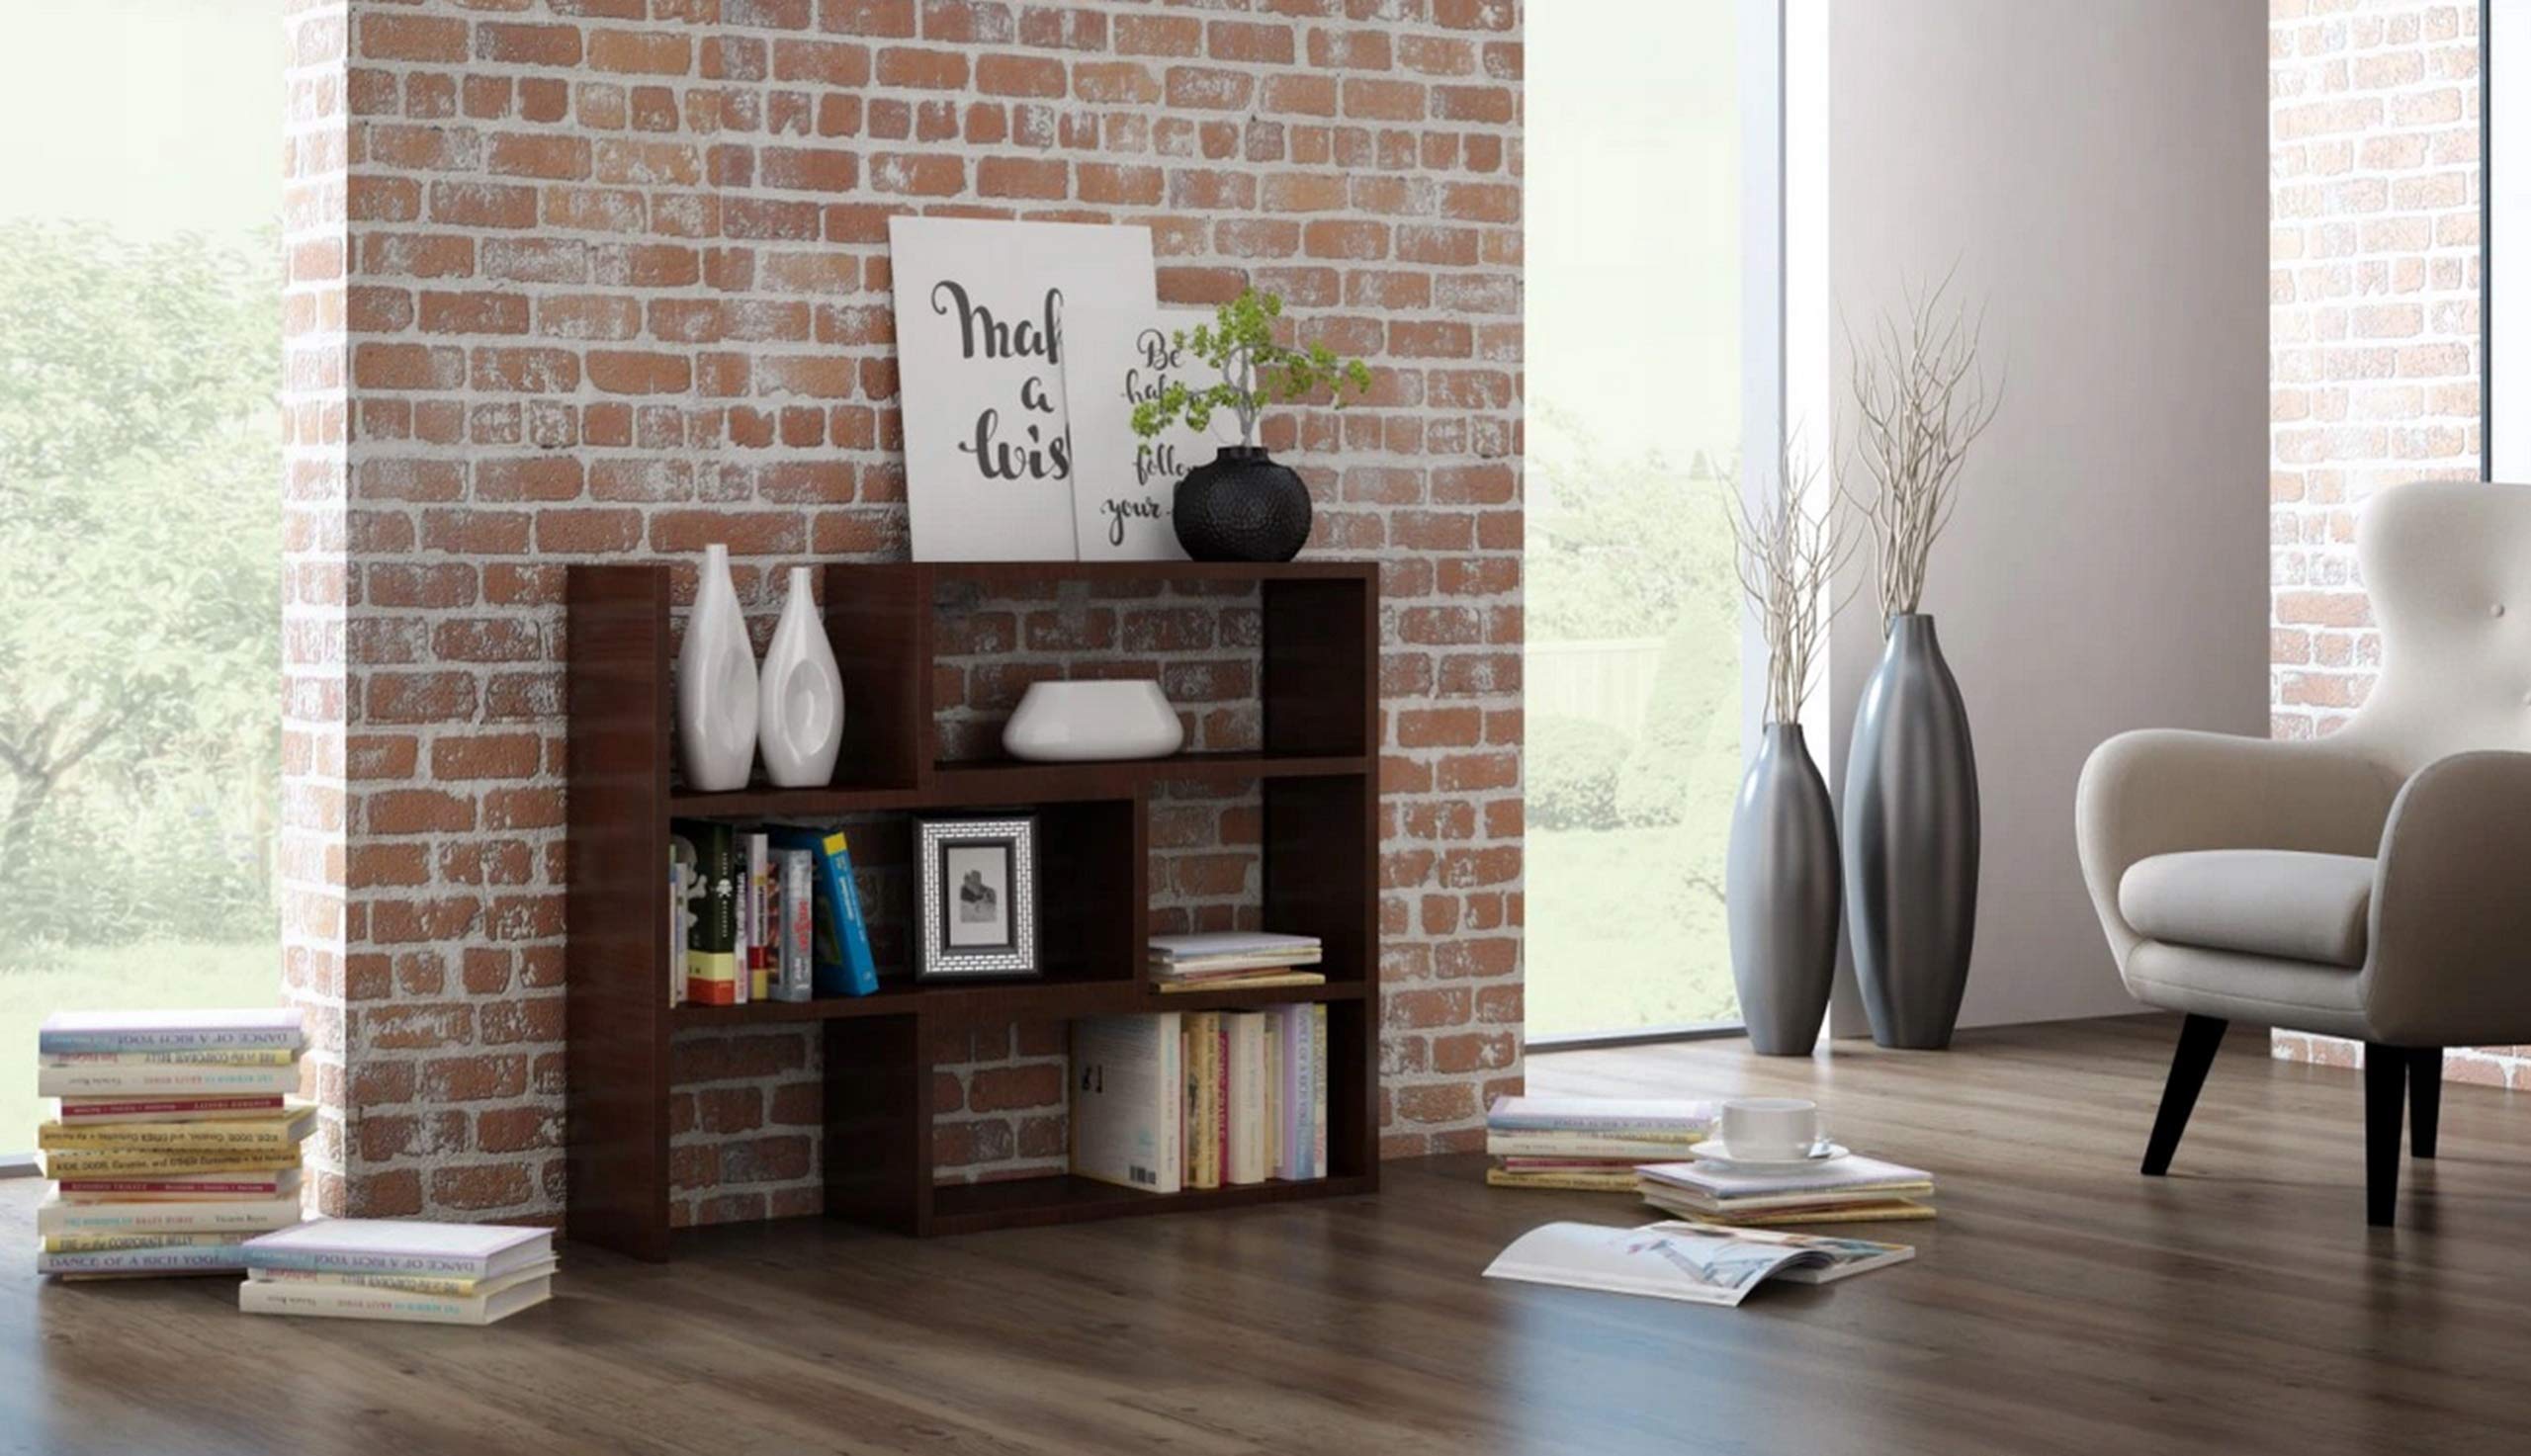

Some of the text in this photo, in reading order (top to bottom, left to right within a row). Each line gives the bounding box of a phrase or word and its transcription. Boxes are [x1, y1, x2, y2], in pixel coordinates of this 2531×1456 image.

[931, 281, 1063, 365] Mak
[1137, 329, 1185, 371] Be
[1020, 376, 1054, 413] a
[958, 408, 1072, 479] Wis
[1132, 443, 1193, 485] follo
[1098, 496, 1162, 546] your
[160, 1034, 195, 1045] RICH
[216, 1034, 234, 1044] OF
[240, 1033, 287, 1044] DANCE
[48, 1257, 96, 1266] DANCE
[104, 1256, 123, 1266] OF
[143, 1255, 178, 1265] RICH
[350, 1256, 386, 1267] RICH
[405, 1258, 424, 1269] OF
[428, 1259, 475, 1272] DANCE
